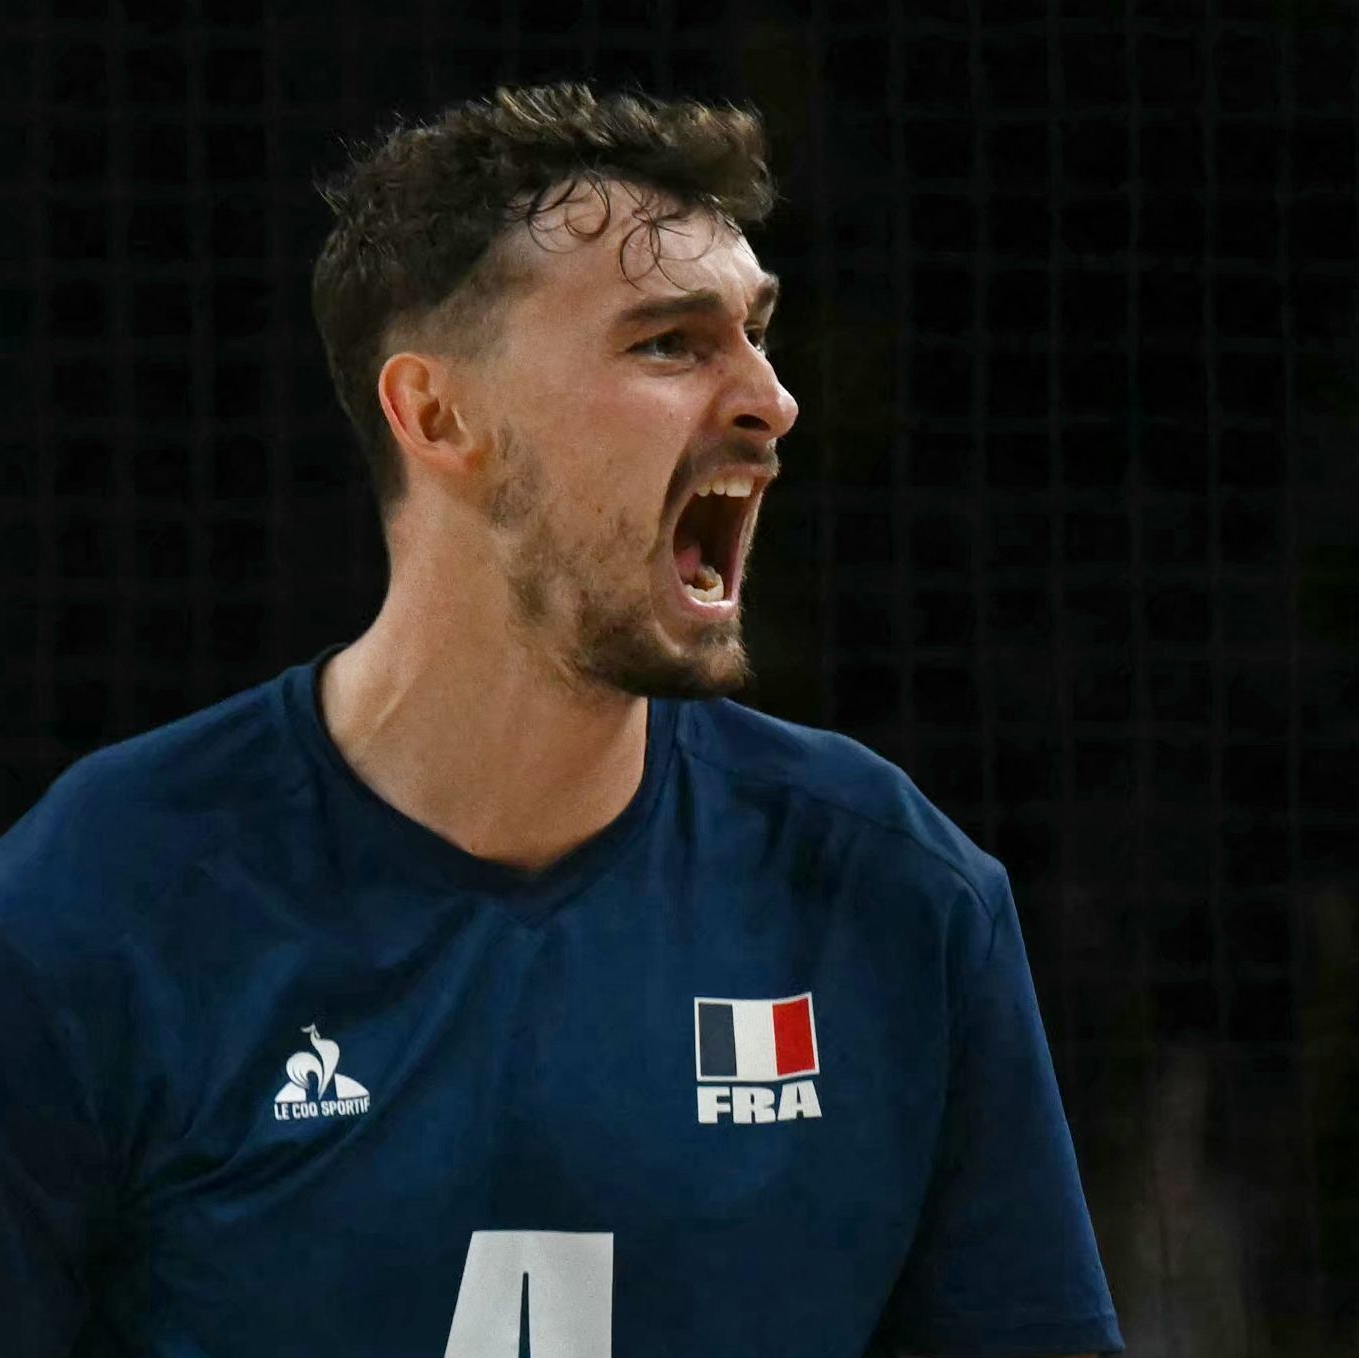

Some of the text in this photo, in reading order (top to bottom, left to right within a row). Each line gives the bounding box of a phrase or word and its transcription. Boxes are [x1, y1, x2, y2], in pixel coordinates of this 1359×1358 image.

[274, 1095, 370, 1120] LE COQ SPORTIF
[697, 1080, 822, 1124] FRA
